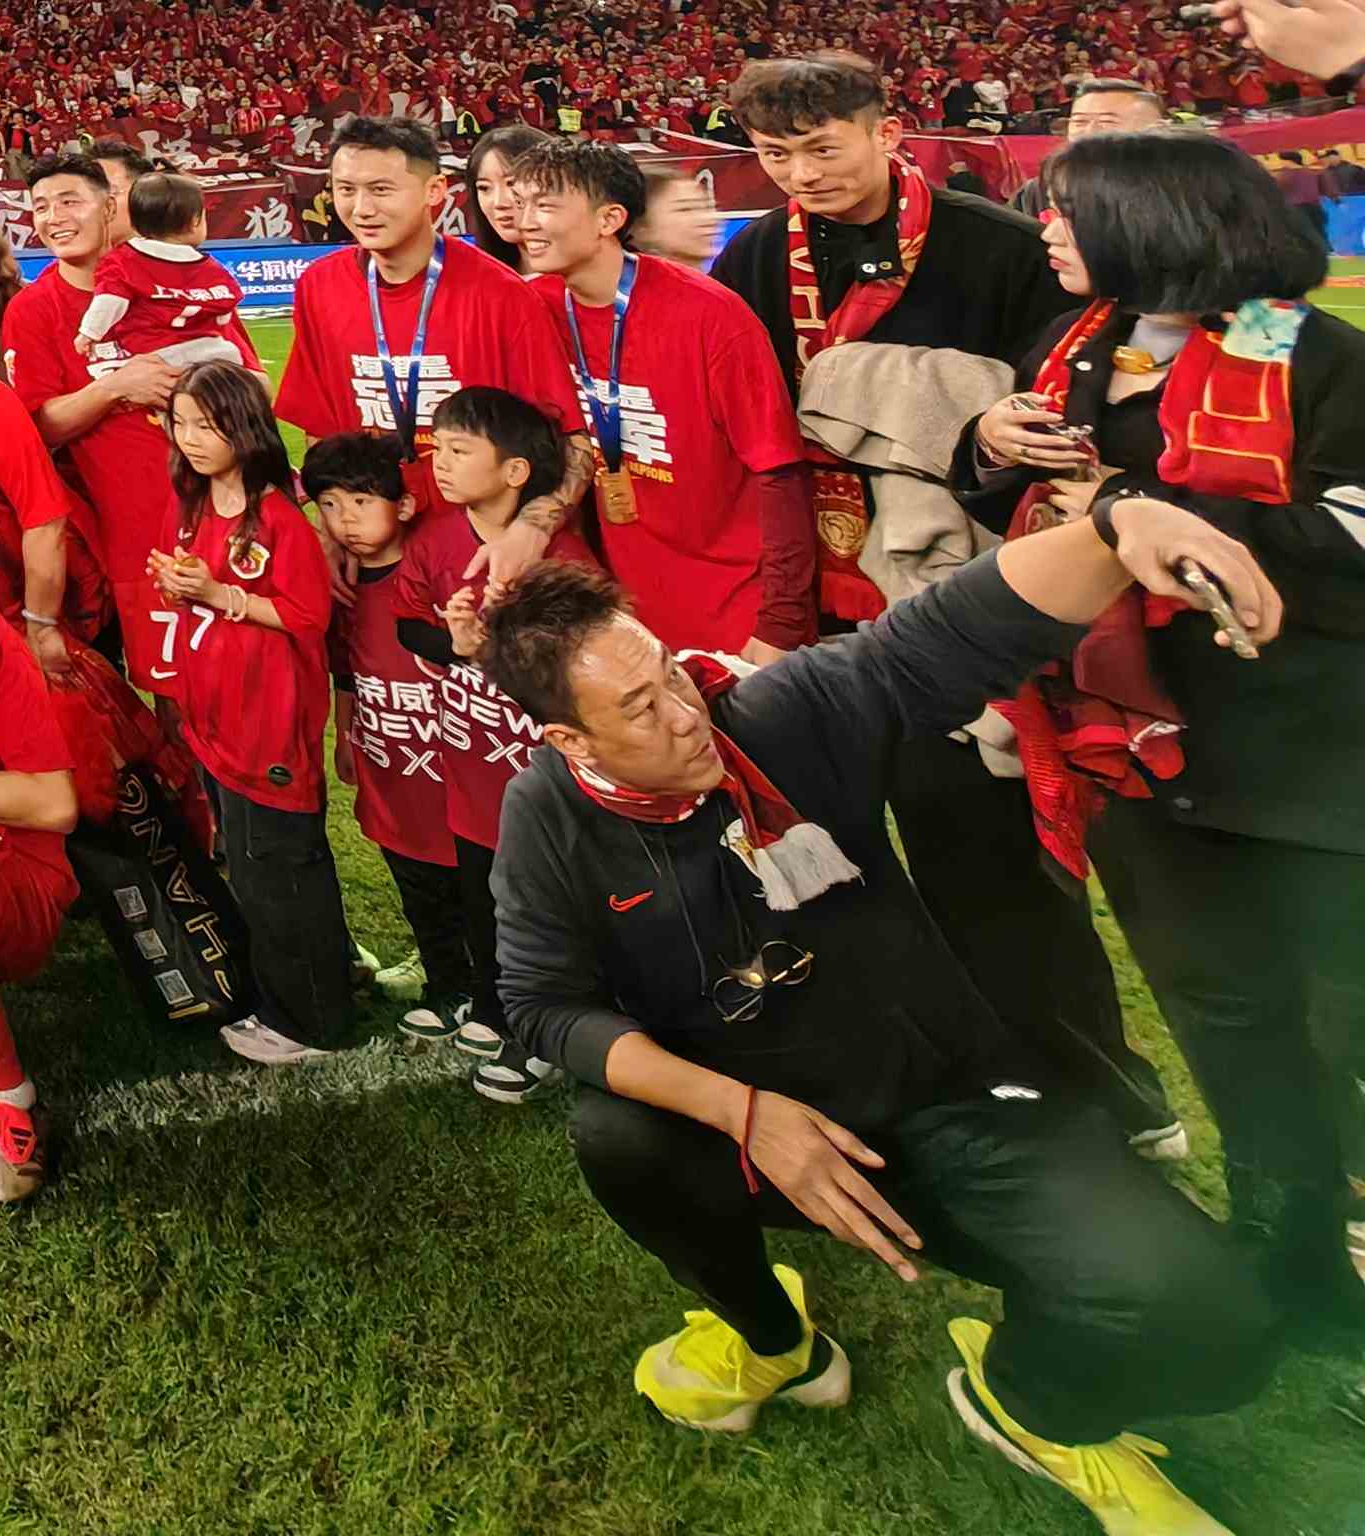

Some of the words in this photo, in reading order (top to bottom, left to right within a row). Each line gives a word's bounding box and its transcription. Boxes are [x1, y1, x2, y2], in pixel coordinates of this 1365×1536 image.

[240, 283, 296, 295] ESOURCES
[353, 671, 439, 714] 荣威
[441, 679, 544, 742] OEW
[357, 701, 442, 744] OEW
